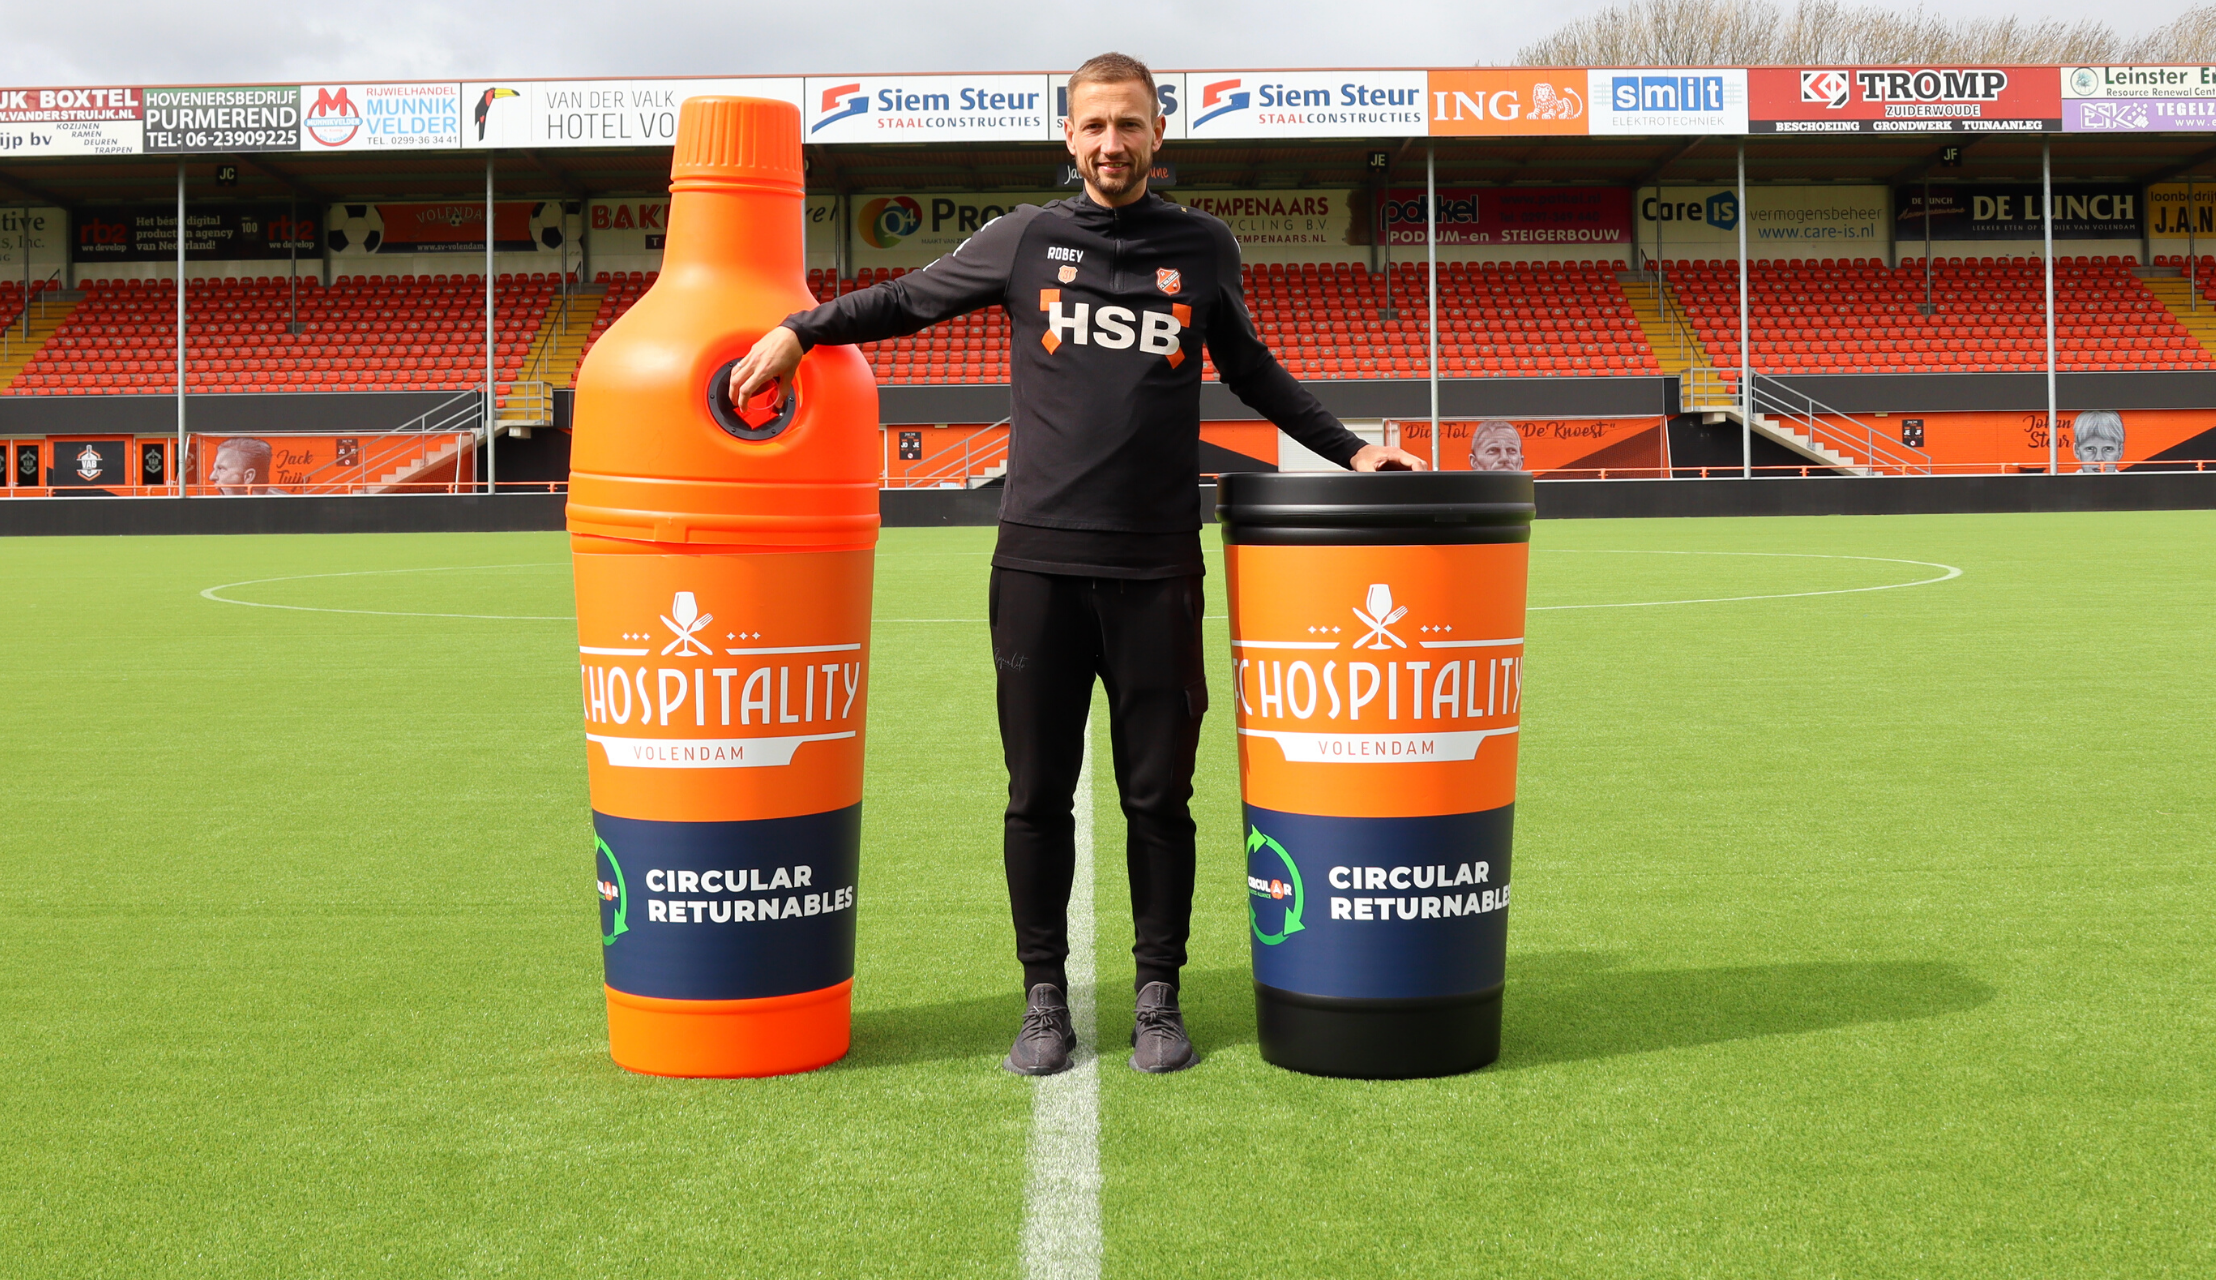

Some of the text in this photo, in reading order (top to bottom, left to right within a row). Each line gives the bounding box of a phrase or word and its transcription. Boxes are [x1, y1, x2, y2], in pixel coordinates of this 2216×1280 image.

[2104, 66, 2188, 85] Leinster
[366, 87, 457, 96] RIJWIELHANDEL
[1857, 70, 2007, 100] TROMP
[2106, 88, 2149, 97] Resource
[2152, 88, 2192, 97] Renewal
[40, 88, 139, 108] BOXTEL
[146, 90, 297, 106] HOVENIERSBEDRIJF
[546, 90, 675, 109] VAN DER VALK
[877, 87, 949, 112] Siem
[959, 86, 1039, 110] Steur
[1259, 83, 1420, 107] Siem Steur
[1615, 78, 1721, 109] smit
[367, 97, 456, 115] MUNNIK
[1432, 90, 1521, 121] ING
[1885, 105, 1981, 118] ZUIDERWOUDE
[56, 122, 100, 130] KOZIJNEN
[146, 107, 297, 130] PURMEREND
[367, 116, 457, 134] VELDER
[548, 113, 631, 139] HOTEL
[877, 116, 1040, 129] STAALCONSTRUCTIES
[1259, 112, 1421, 124] STAALCONSTRUCTIES
[1612, 116, 1724, 126] ELEKTROTECHNIEK
[1775, 120, 2043, 131] BESCHOEIING GRONDWERK TUINAANLEG
[30, 131, 52, 146] bv
[71, 130, 102, 138] RAMEN
[84, 138, 118, 146] DEUREN
[147, 130, 297, 148] TEL: 06-23909225
[367, 135, 458, 145] TEL. 0299-36 34 41
[95, 146, 133, 154] TRAPPEN
[1943, 148, 1958, 161] JF
[1370, 154, 1386, 166] JE
[219, 167, 235, 180] JC
[1926, 197, 1953, 205] UNCH
[2150, 190, 2216, 204] loonbdrij
[416, 206, 498, 223] VOLENDA
[1642, 197, 1735, 221] Care IS
[1751, 206, 1882, 224] vermogensbeheer
[1973, 194, 2135, 221] DE LUNCH
[136, 217, 154, 227] Het
[187, 215, 221, 228] digital
[241, 222, 258, 233] 100
[81, 217, 127, 244] rb2
[136, 228, 234, 240] productn agency
[1389, 230, 1490, 243] PODUM-en
[1501, 228, 1620, 242] STEIGERBOUW
[1758, 222, 1875, 239] www.care-is.nl
[95, 243, 127, 253] develop
[136, 240, 216, 250] van Nedrland!
[1047, 246, 1084, 263] ROBEY
[1049, 301, 1182, 356] HSB
[1405, 421, 1470, 440] Dic Tol
[276, 449, 314, 469] Jack
[1258, 655, 1523, 720] HOSPITALITY
[633, 745, 744, 761] VOLENDAM
[1318, 740, 1434, 756] VOLENDAM
[645, 864, 812, 893] CIRCULAR
[1328, 860, 1490, 890] CIRCULAR
[648, 885, 853, 924] RETURNABLES
